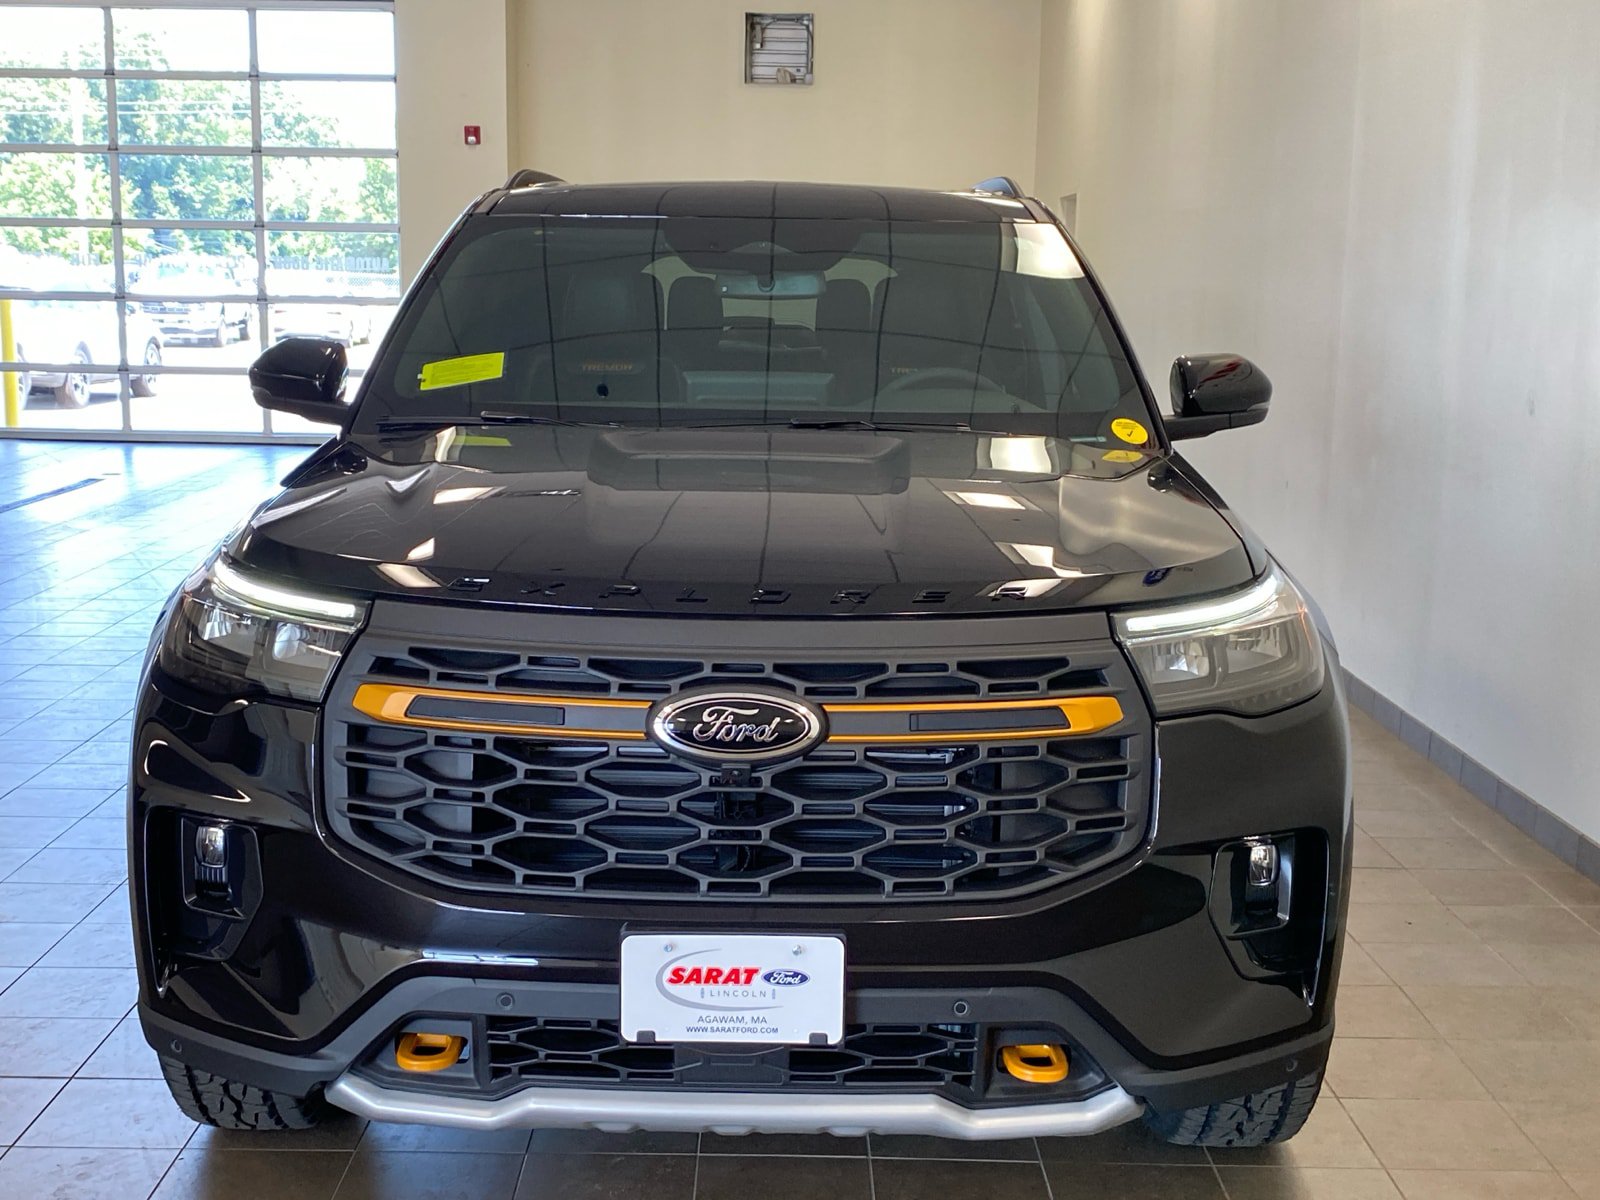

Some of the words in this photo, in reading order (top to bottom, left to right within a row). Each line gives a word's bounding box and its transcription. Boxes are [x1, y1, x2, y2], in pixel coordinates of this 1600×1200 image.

[693, 706, 781, 743] Ford
[668, 967, 759, 985] SARAT
[769, 970, 802, 985] Ford
[710, 989, 767, 998] LINCOLN
[697, 1015, 748, 1024] AGAWAM,
[751, 1016, 767, 1024] MA
[686, 1025, 779, 1034] WWW.SARATFORD.COM
